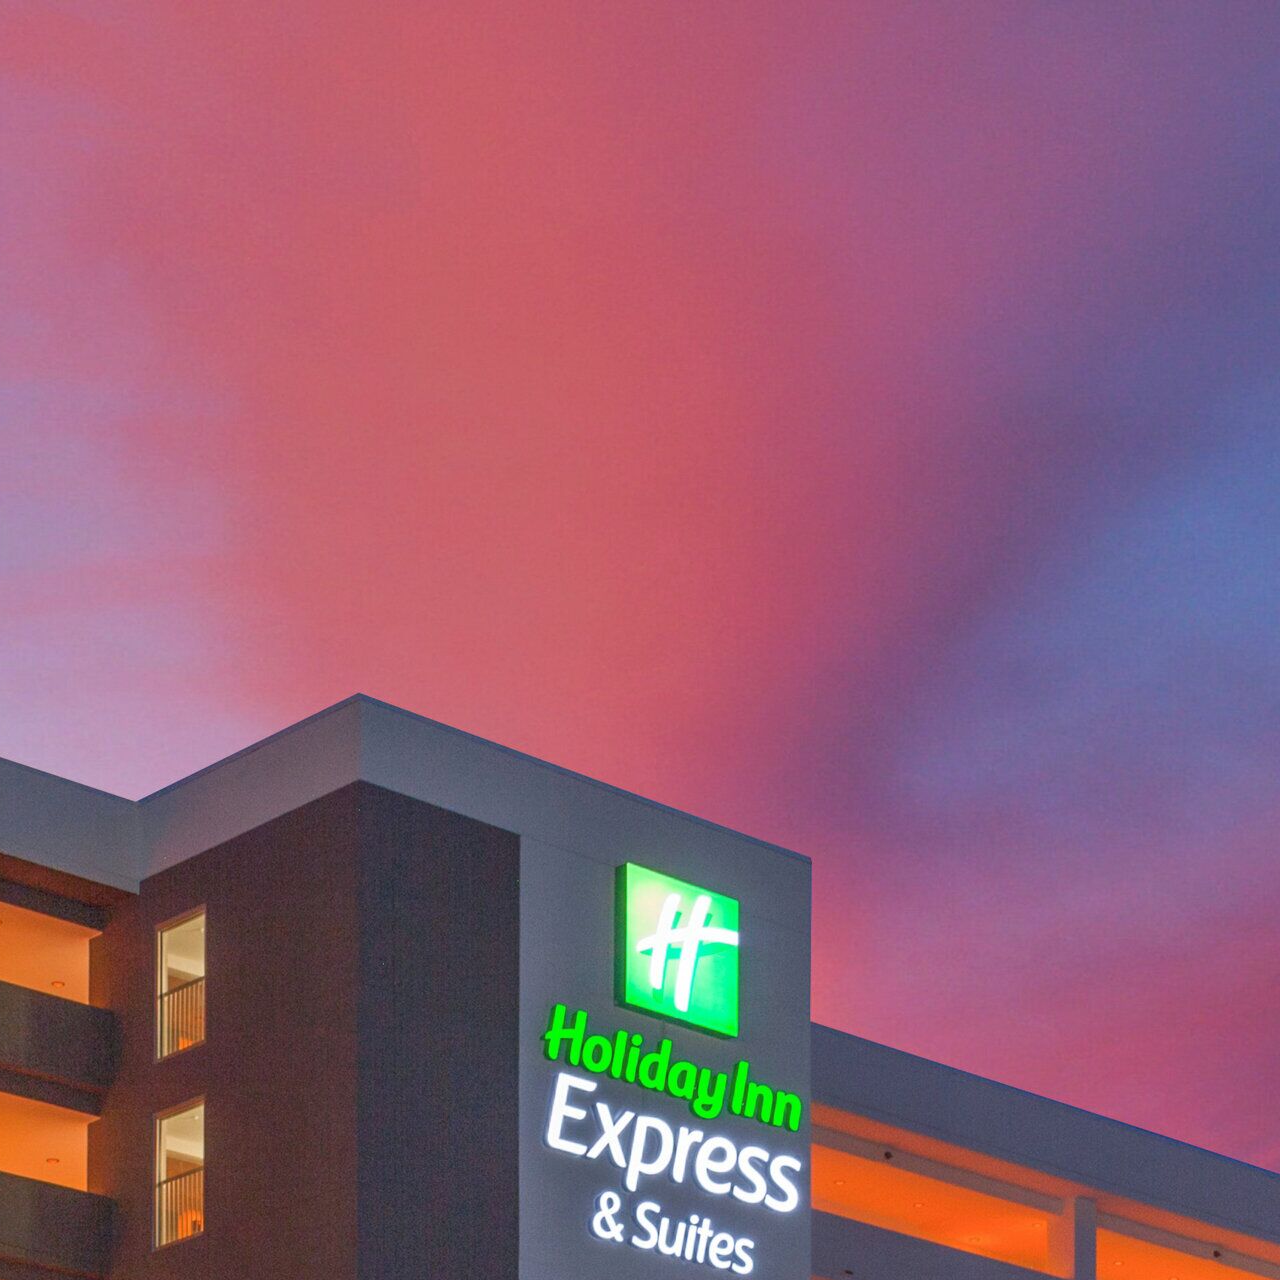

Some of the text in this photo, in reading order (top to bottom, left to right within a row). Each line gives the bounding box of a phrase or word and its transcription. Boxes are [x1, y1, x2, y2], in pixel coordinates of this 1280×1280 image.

[543, 1002, 802, 1133] Holiday Inn
[544, 1071, 803, 1214] Express
[591, 1190, 755, 1276] & Suites
